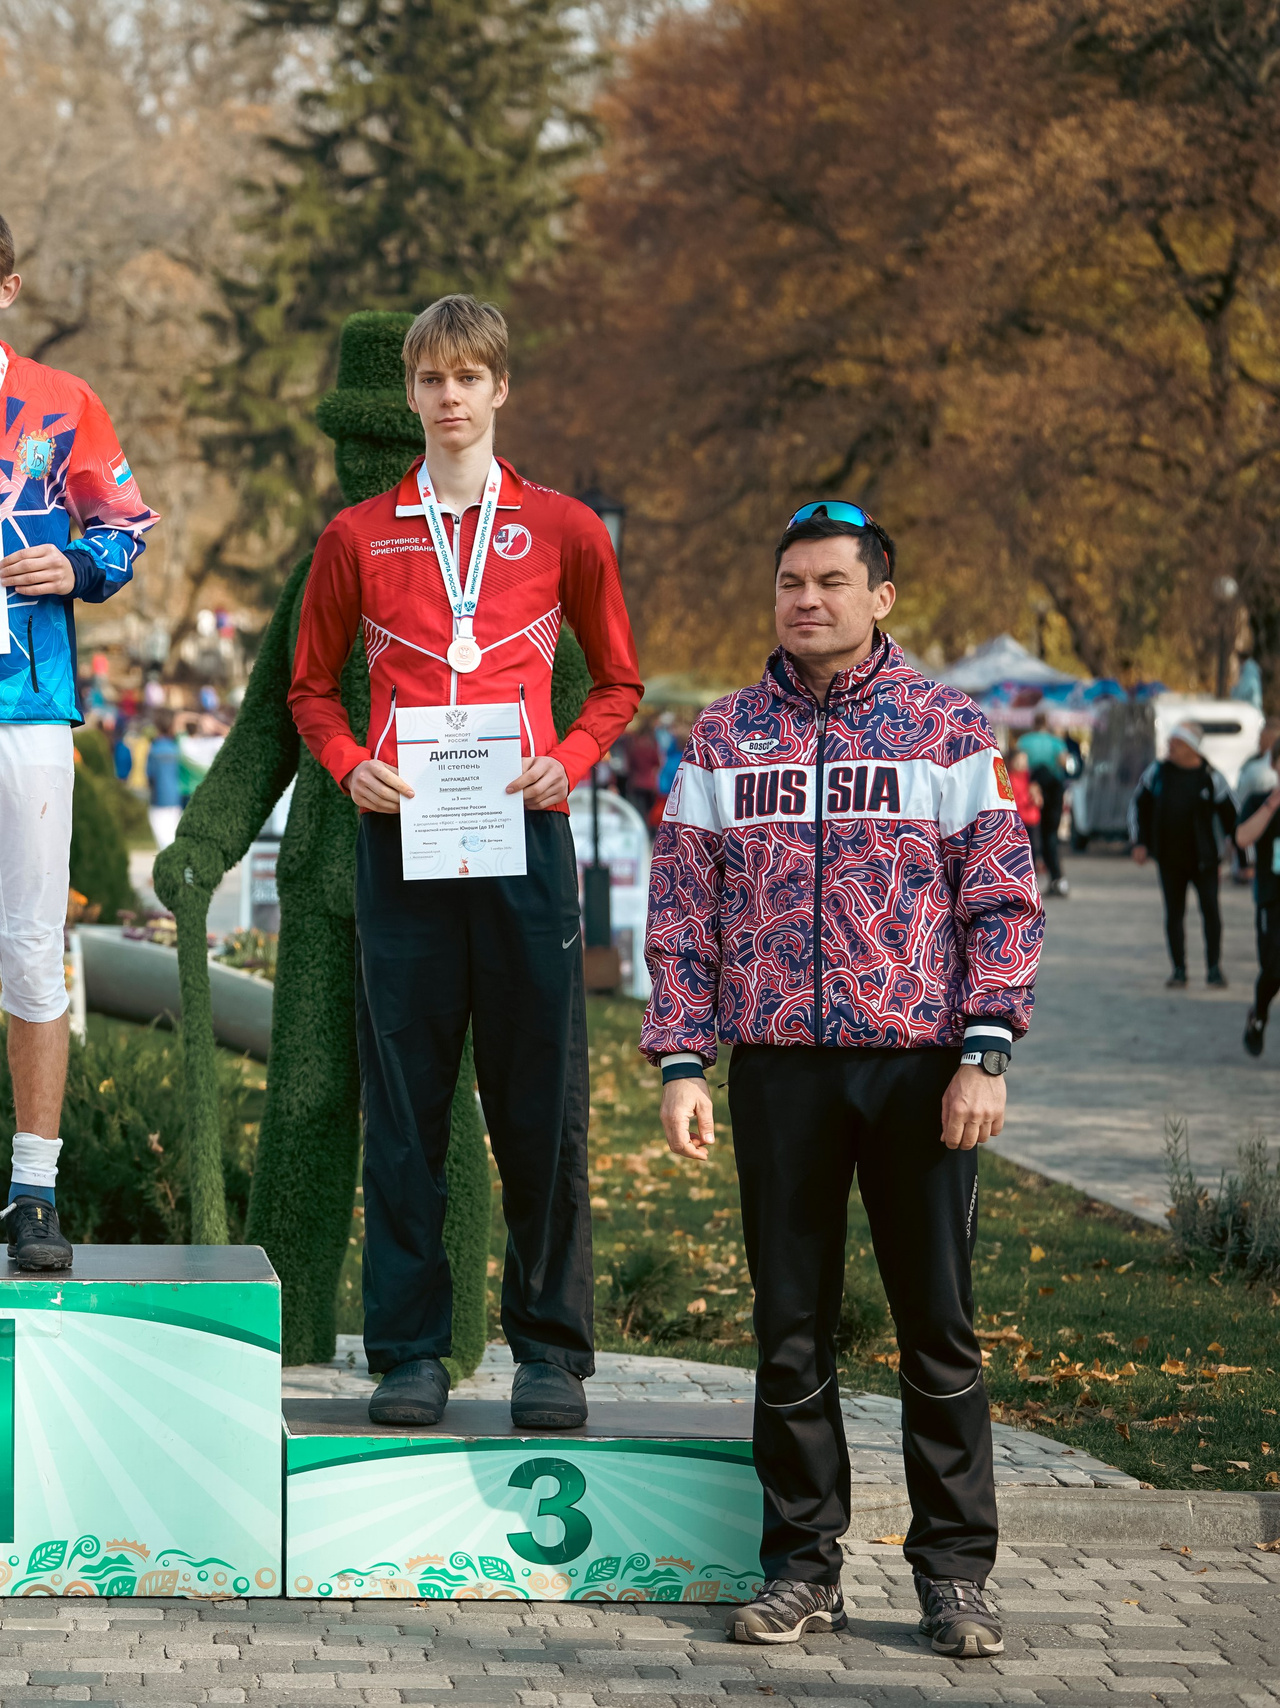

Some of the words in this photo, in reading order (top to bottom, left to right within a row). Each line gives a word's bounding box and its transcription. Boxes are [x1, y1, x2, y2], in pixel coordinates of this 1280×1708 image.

[370, 538, 420, 548] СПОРТИВНОЕ
[371, 545, 436, 556] ОРИЕНТИРОВАНИ
[428, 505, 444, 549] МИНИСТЕРСТВО
[441, 549, 451, 573] СПОРТА
[448, 573, 458, 597] РОССИИ
[470, 549, 482, 594] МИНИСТЕРСТВО
[479, 526, 487, 550] СПОРТА
[483, 501, 492, 525] РОССИИ
[430, 749, 488, 762] ДИПЛОМ
[506, 1457, 593, 1566] 3
